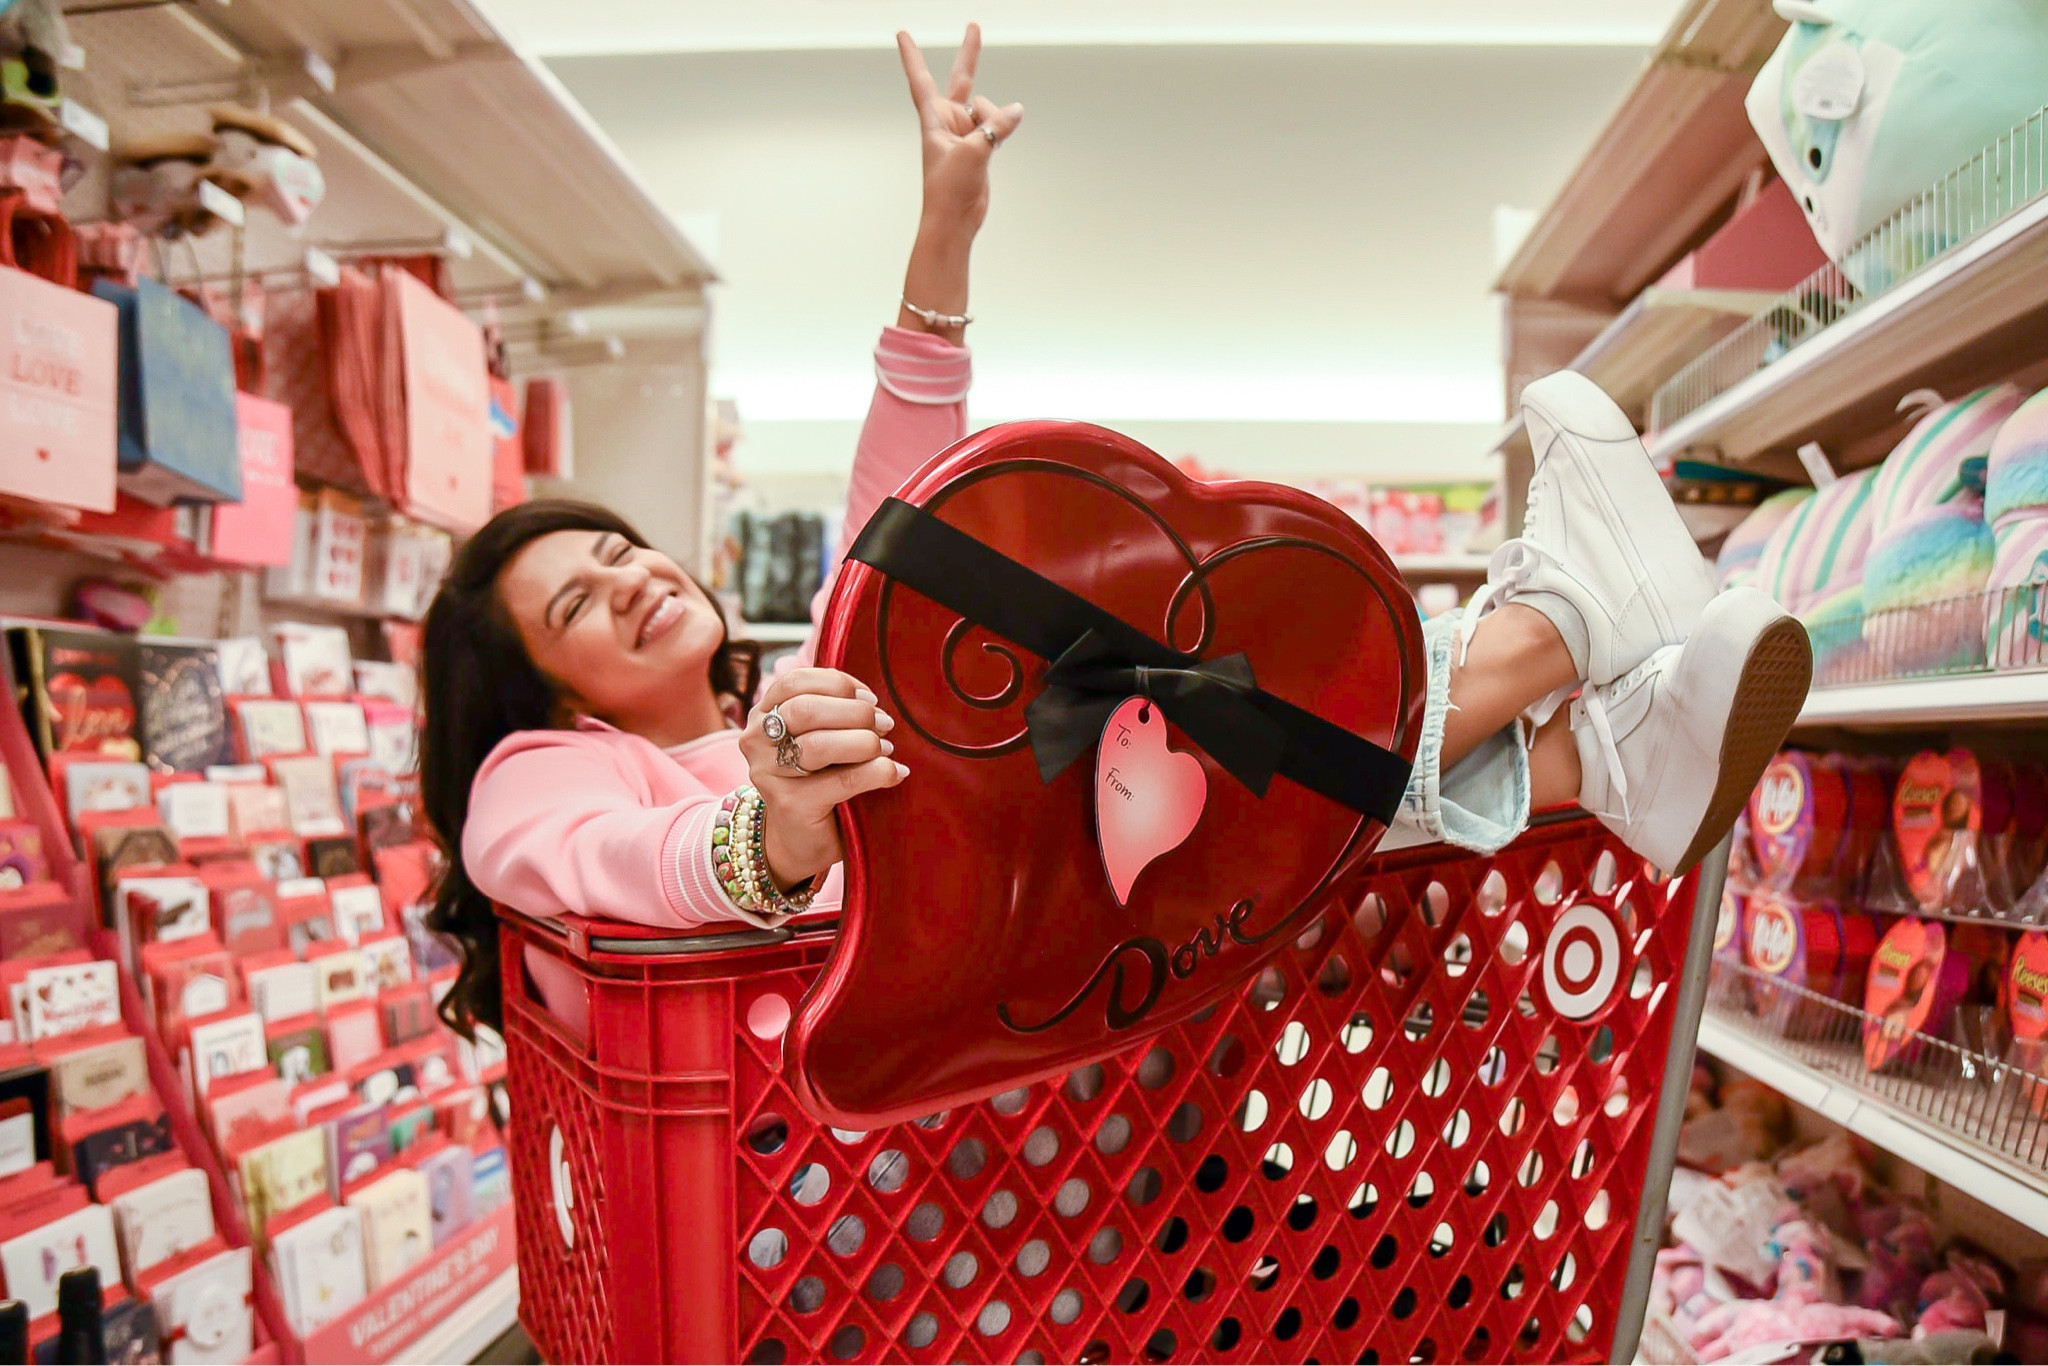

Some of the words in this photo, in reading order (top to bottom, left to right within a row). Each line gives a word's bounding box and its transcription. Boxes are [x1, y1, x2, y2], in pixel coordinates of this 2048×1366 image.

[11, 353, 82, 397] LOVE
[1116, 723, 1132, 750] To:
[1105, 766, 1135, 802] From:
[996, 896, 1280, 1031] Dove
